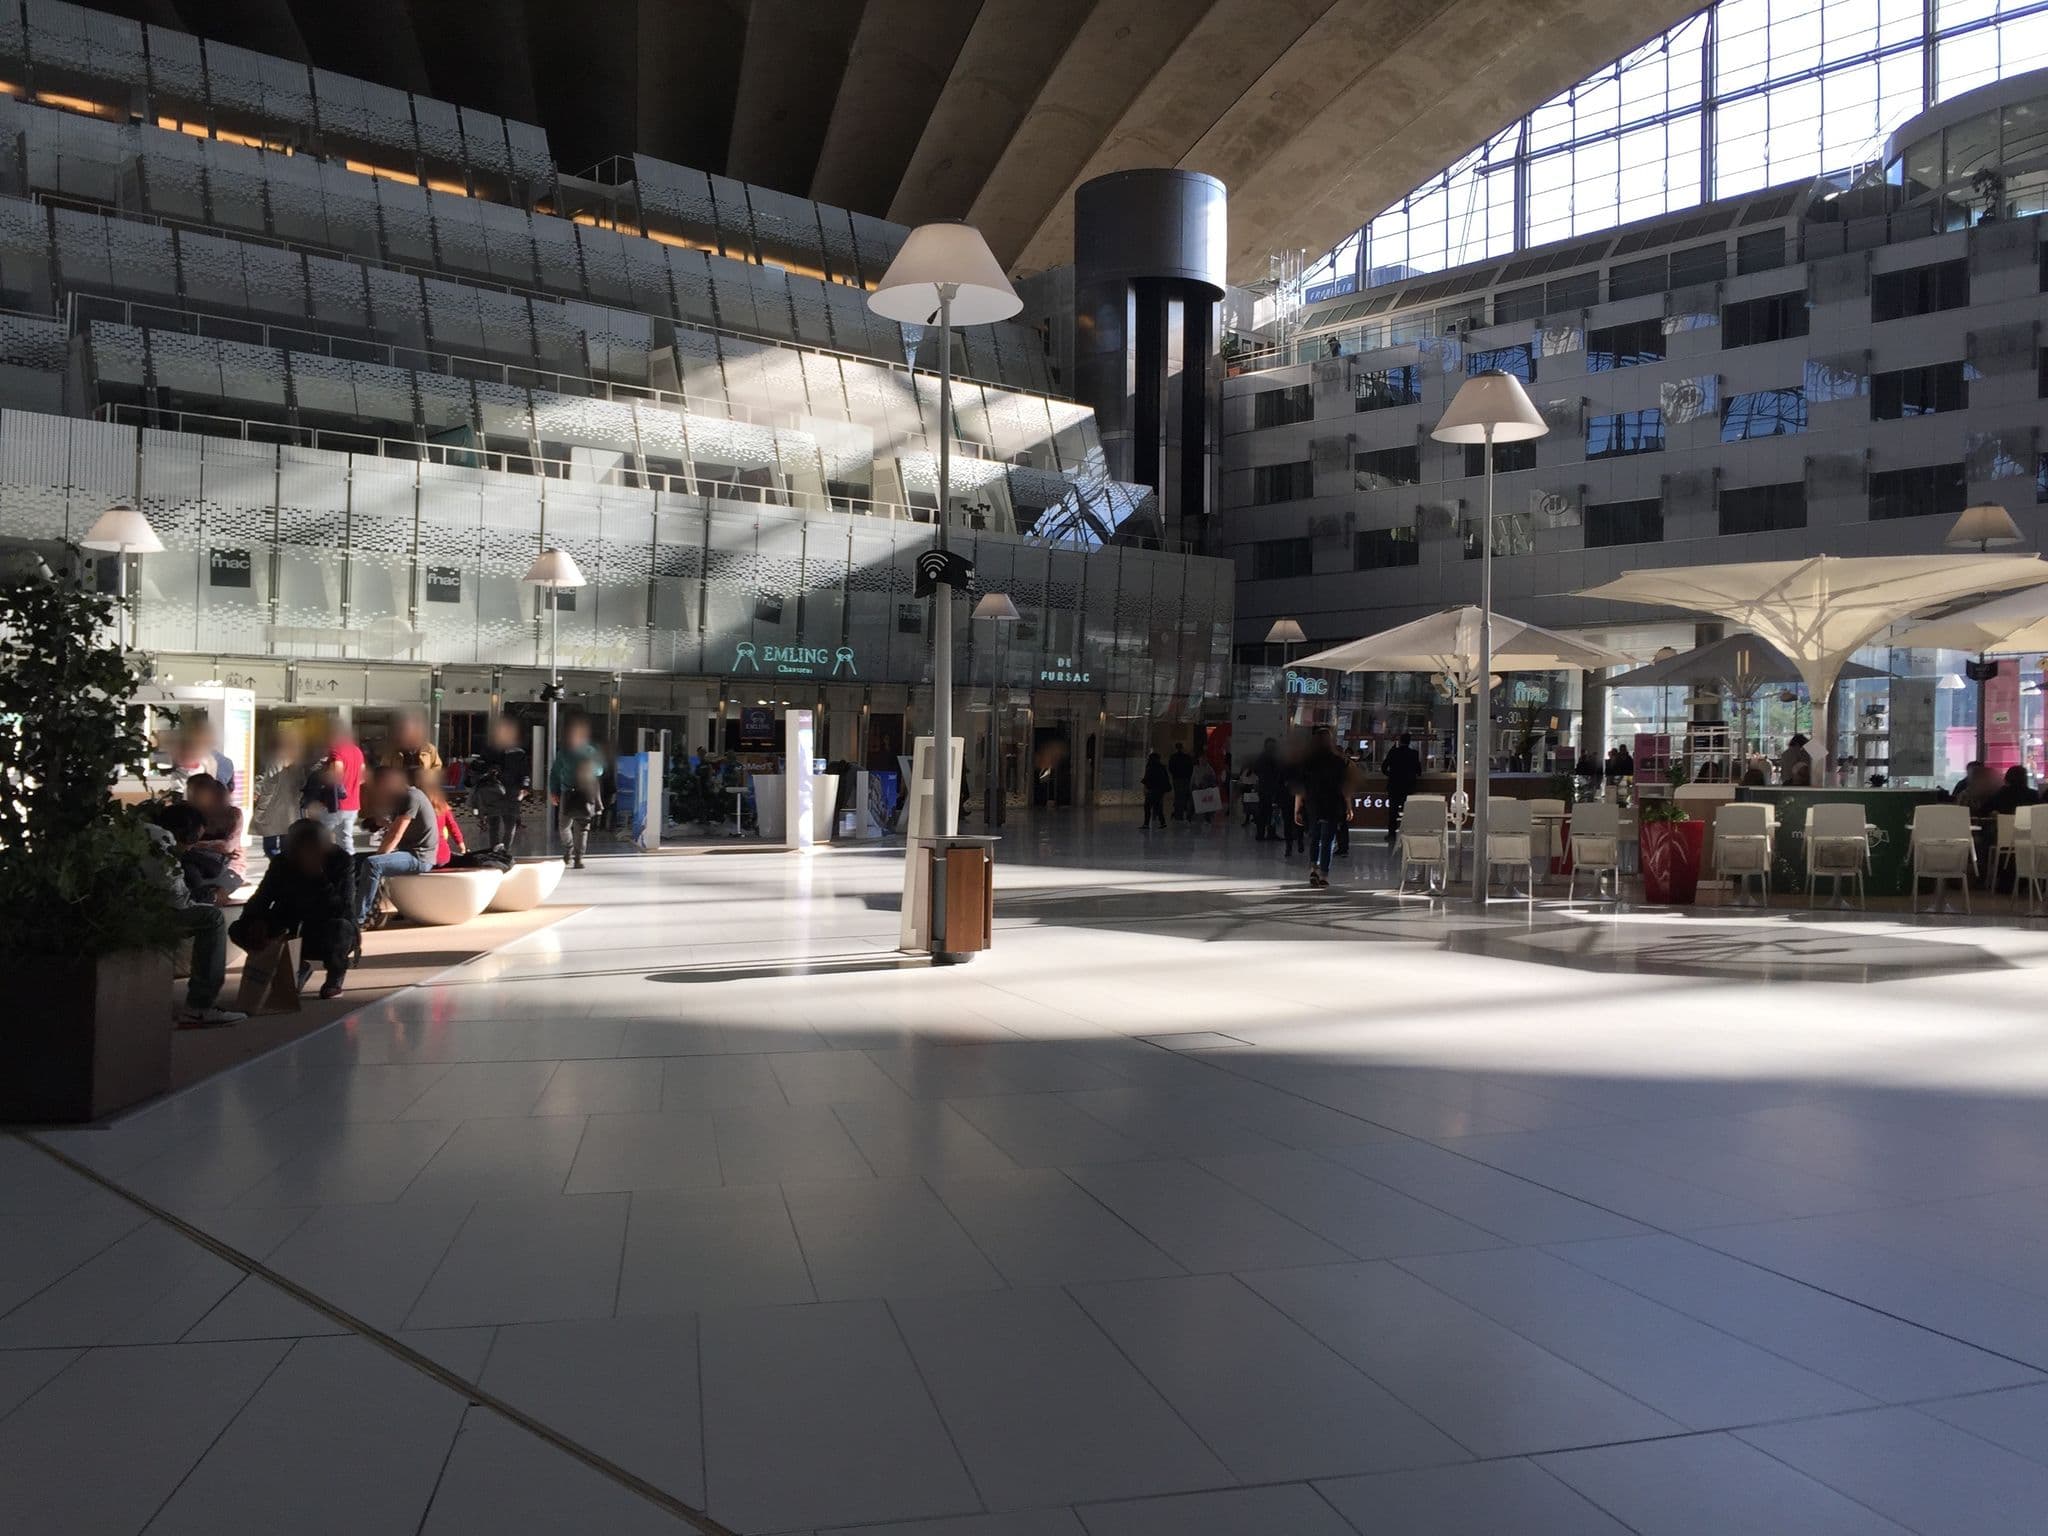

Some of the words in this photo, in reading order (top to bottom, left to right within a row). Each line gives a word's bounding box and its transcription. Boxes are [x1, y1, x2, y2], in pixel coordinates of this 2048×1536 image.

[211, 553, 250, 569] fnac
[427, 573, 460, 586] fnac
[763, 646, 829, 665] EMLING
[1057, 657, 1072, 668] DE
[1040, 671, 1090, 683] FURSAC
[1285, 671, 1328, 694] fnac
